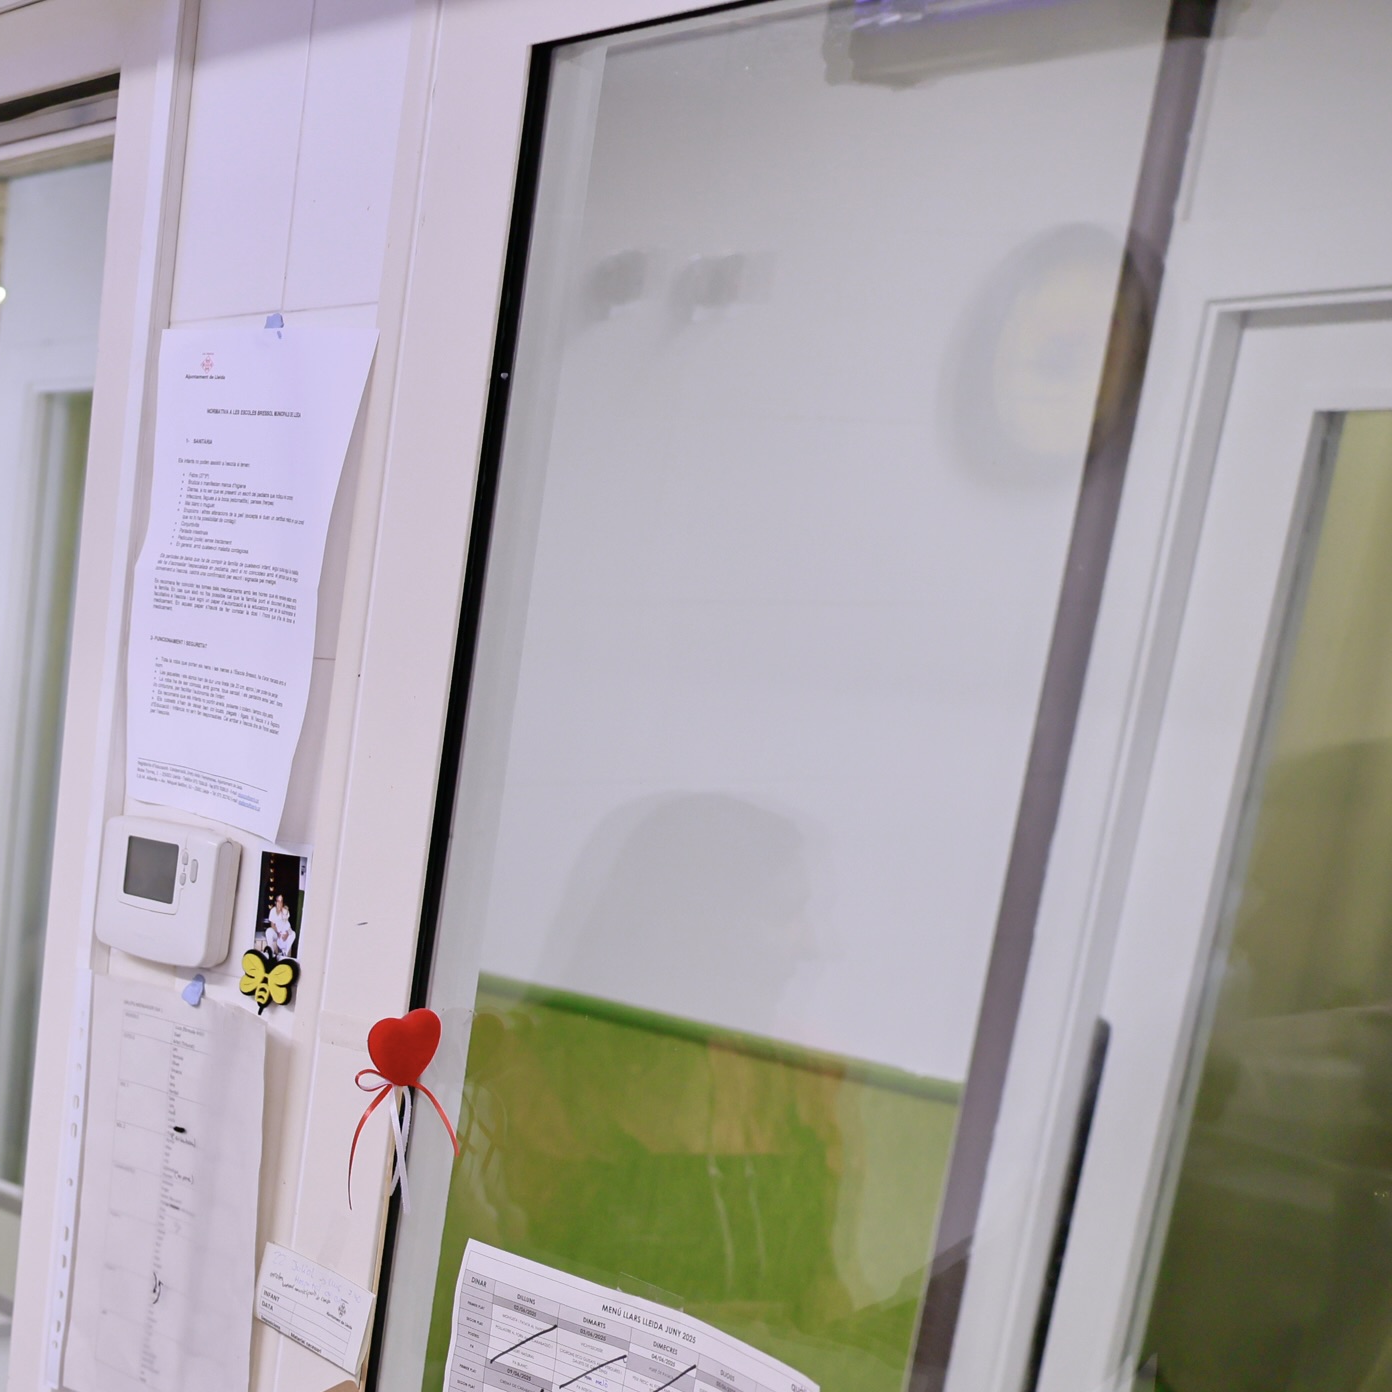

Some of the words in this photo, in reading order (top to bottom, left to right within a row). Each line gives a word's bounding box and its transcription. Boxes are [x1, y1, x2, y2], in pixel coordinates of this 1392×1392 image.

[471, 1276, 487, 1288] DINAR
[263, 1290, 280, 1302] INFANT
[517, 1294, 536, 1305] DILLUNS
[261, 1300, 274, 1311] DATA
[583, 1317, 606, 1329] DIMARTS
[601, 1304, 622, 1317] MENÚ
[623, 1311, 641, 1324] LLARS
[642, 1318, 663, 1331] LLEIDA
[665, 1326, 681, 1337] JUNY
[682, 1332, 697, 1344] 2025
[579, 1327, 606, 1342] 03/06/2025
[653, 1341, 678, 1355] DIMECRES
[651, 1352, 675, 1367] 04/06/2025
[506, 1367, 531, 1382] 09/06/2025
